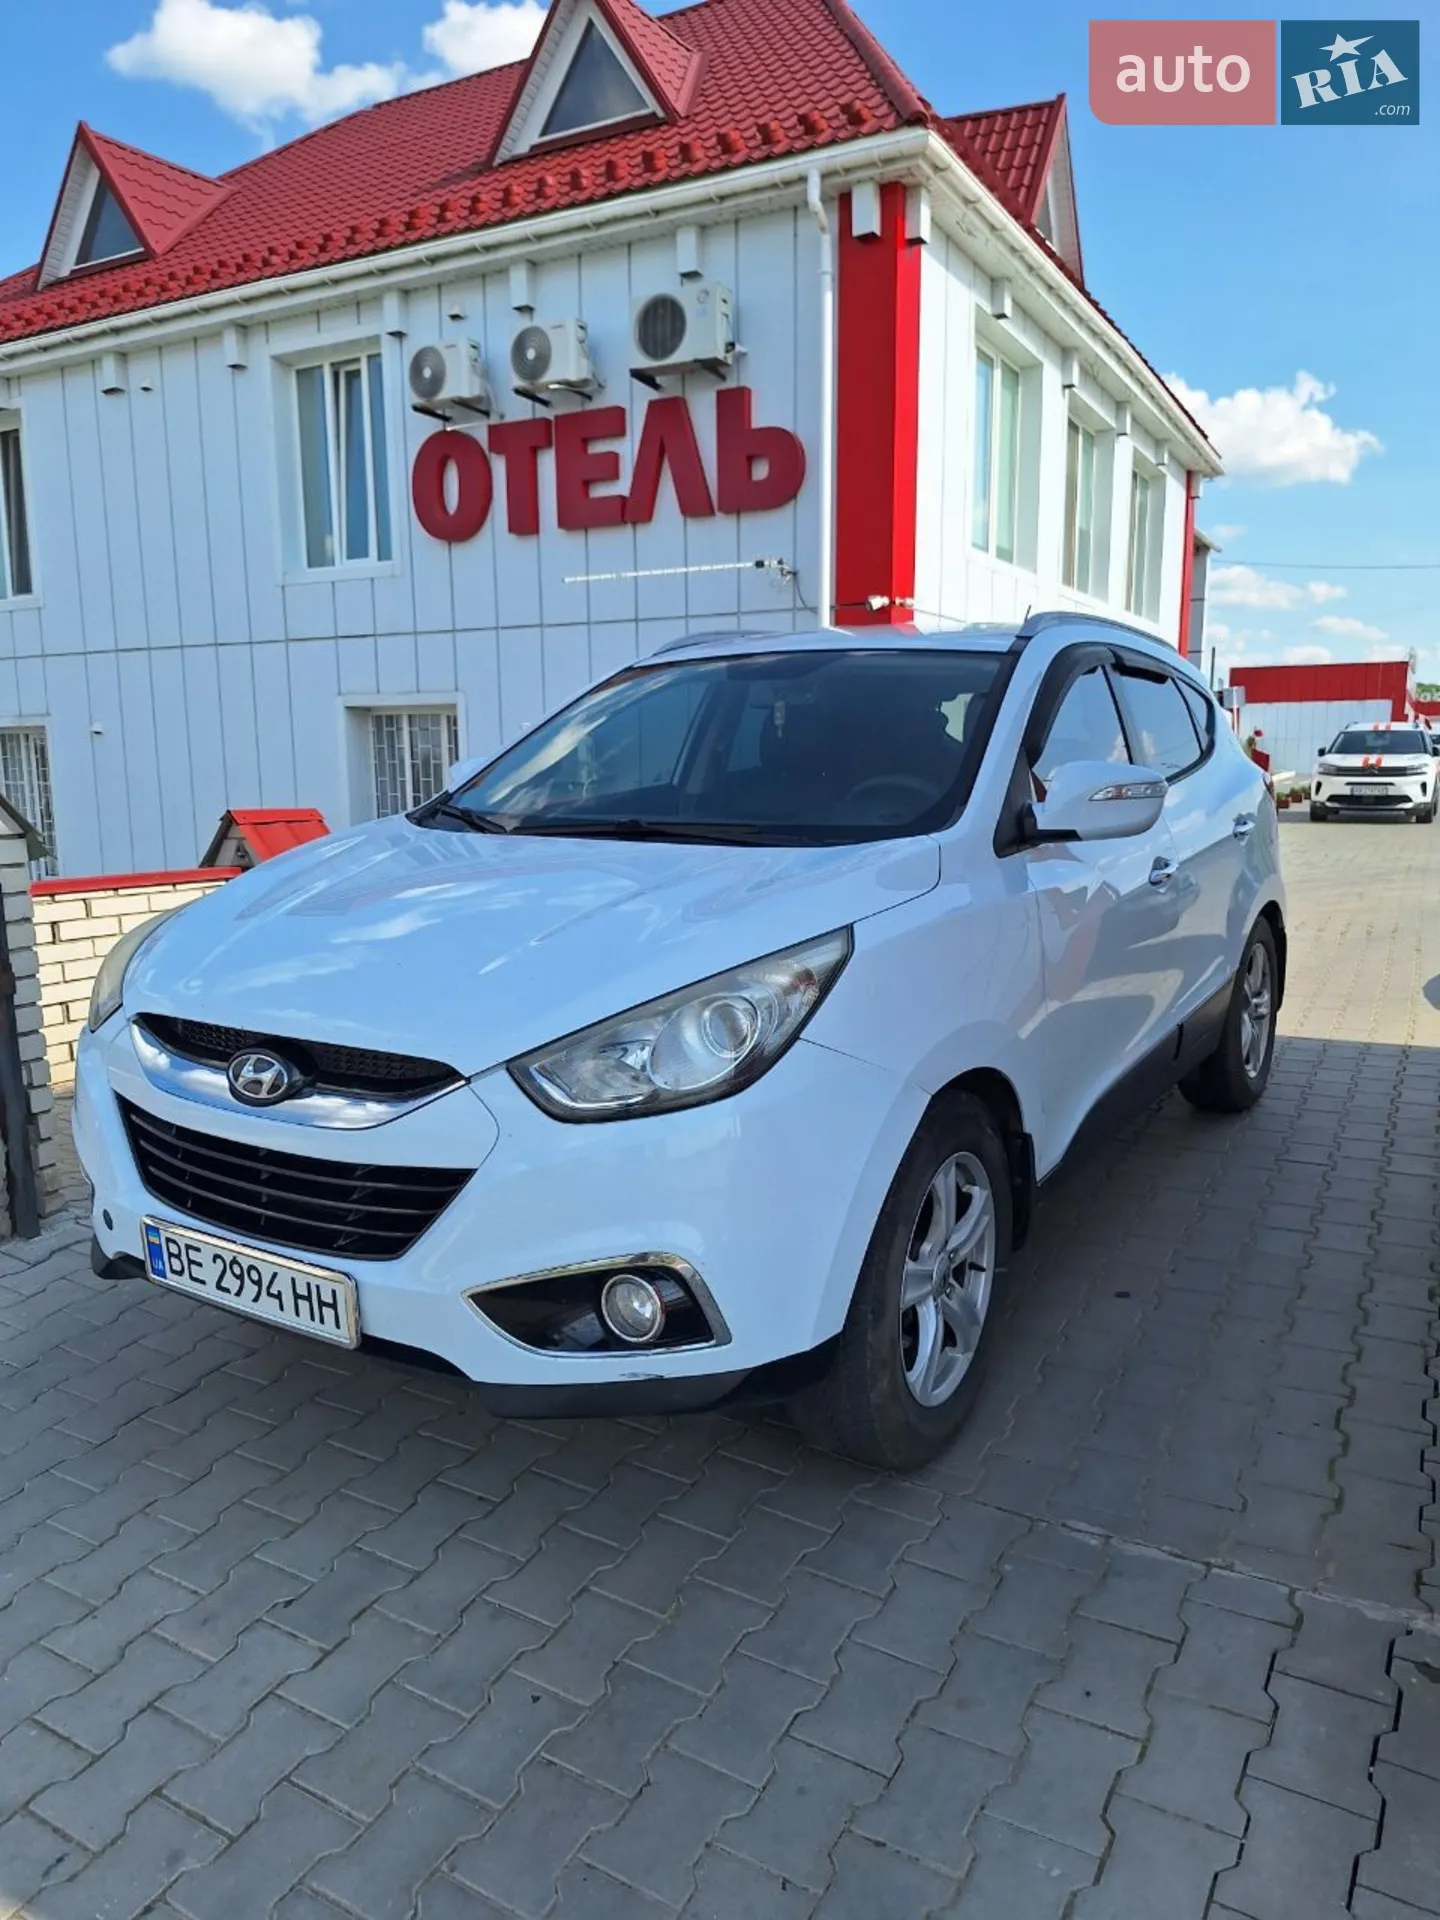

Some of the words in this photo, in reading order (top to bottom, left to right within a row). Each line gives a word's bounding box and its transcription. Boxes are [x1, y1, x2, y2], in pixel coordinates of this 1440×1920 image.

[412, 385, 806, 543] ОТЕЛЬ
[165, 1236, 207, 1286] BE
[212, 1253, 285, 1312] 2994
[291, 1276, 341, 1330] HH
